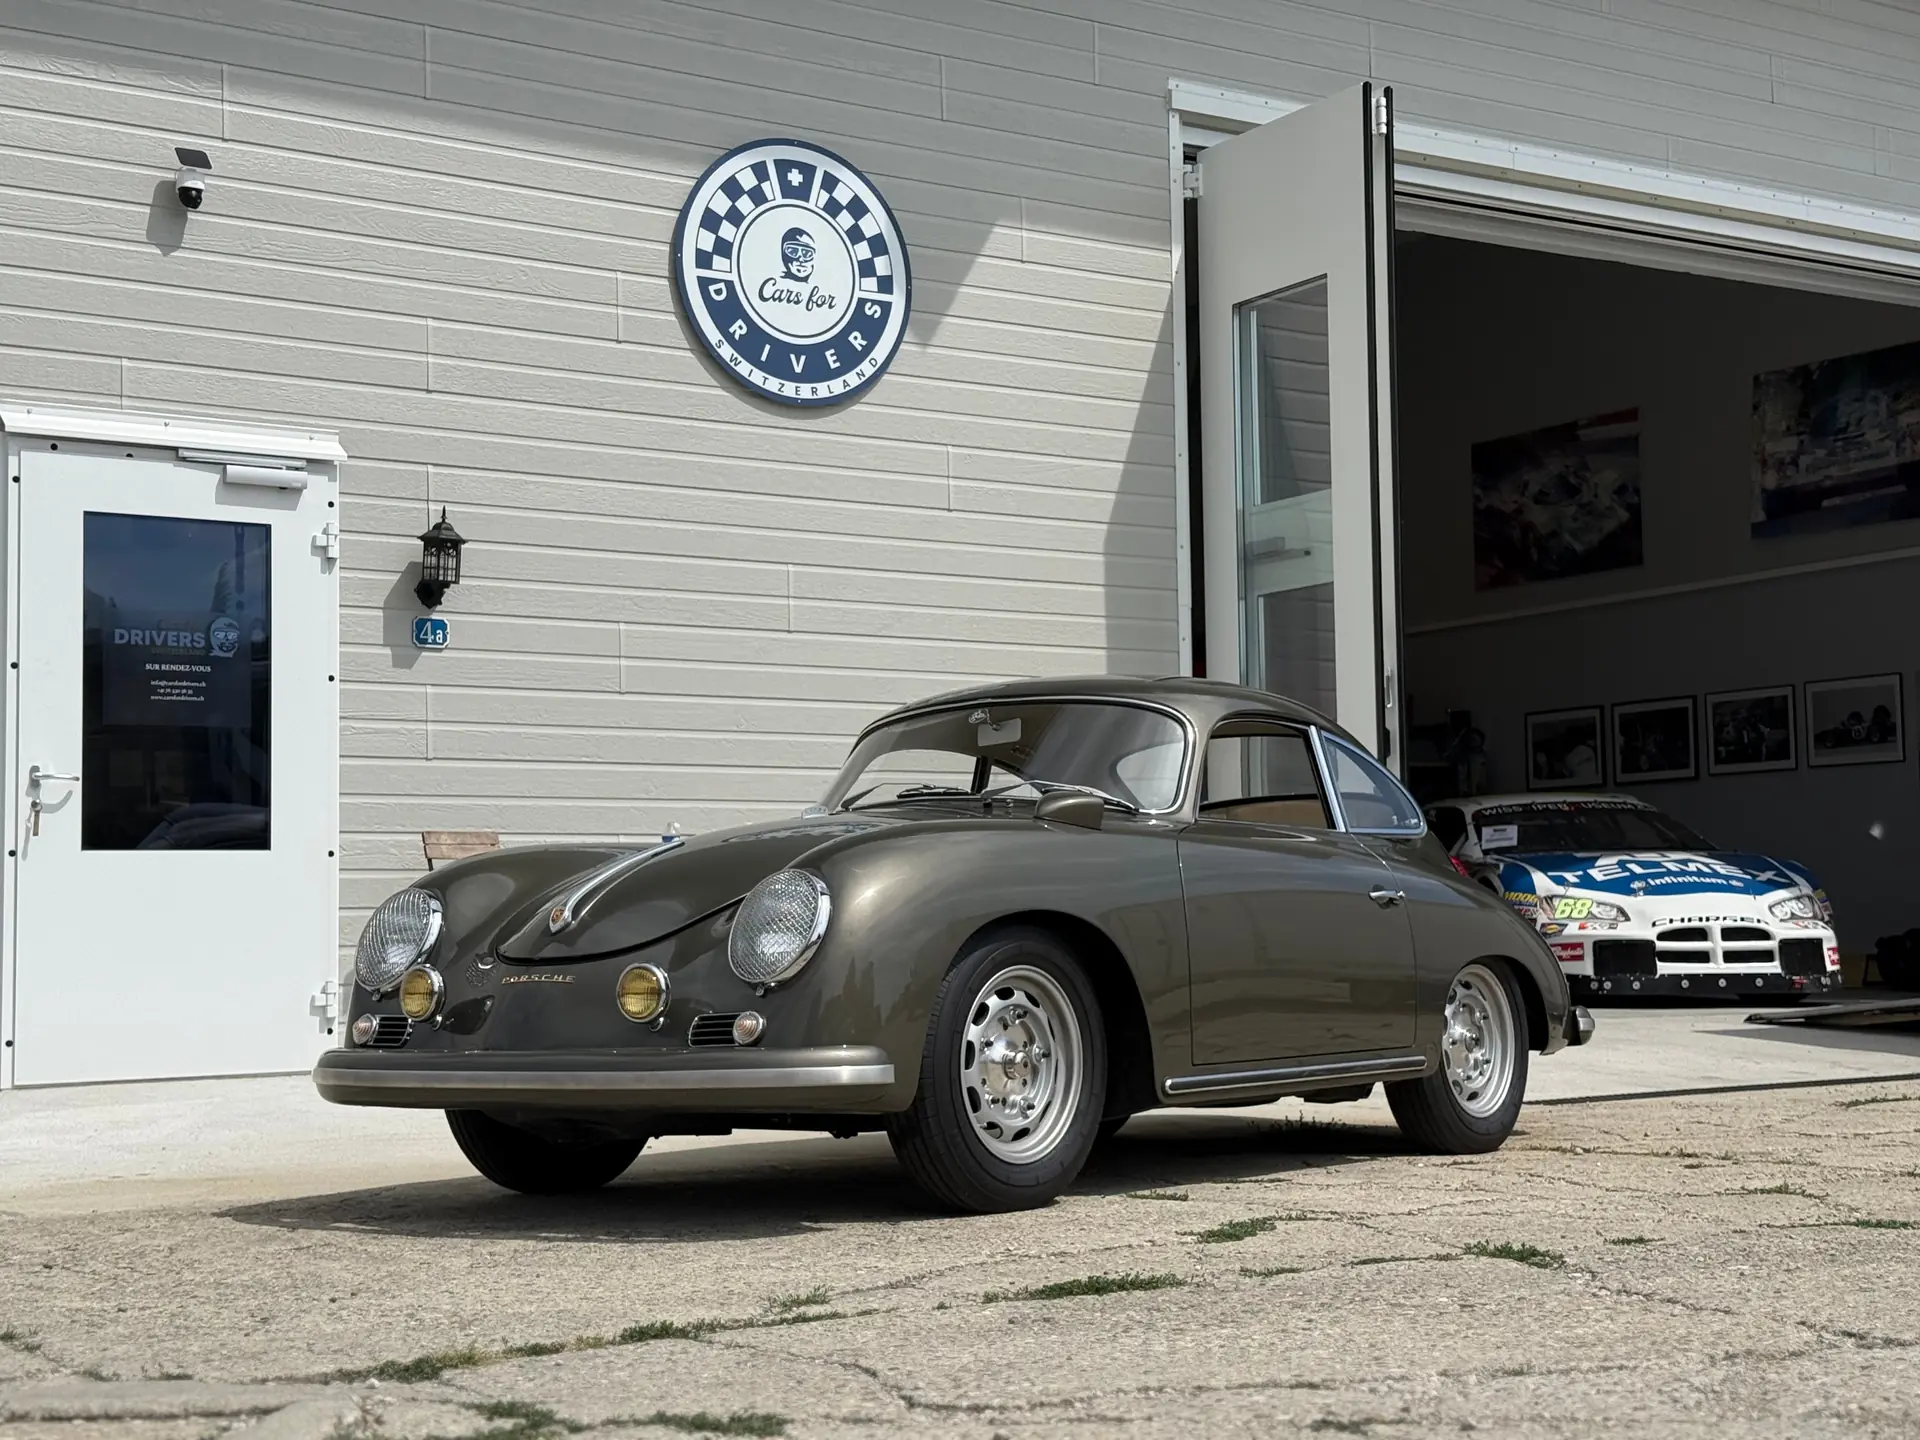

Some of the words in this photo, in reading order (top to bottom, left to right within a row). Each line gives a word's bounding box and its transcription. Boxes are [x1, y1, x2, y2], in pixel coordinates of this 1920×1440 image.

[758, 277, 803, 305] Cars
[805, 286, 837, 312] for
[708, 282, 882, 374] DRIVERS
[715, 338, 879, 396] SWITZERLAND
[114, 628, 206, 648] DRIVERS
[420, 620, 443, 644] 4a
[145, 662, 160, 671] SUR
[161, 663, 212, 673] RENDEZ-VOUS
[1547, 858, 1796, 884] TELMEX
[1647, 875, 1728, 887] infinitum
[1554, 897, 1594, 919] 68
[1652, 915, 1770, 928] CHARGER
[501, 973, 576, 984] PORSCHE
